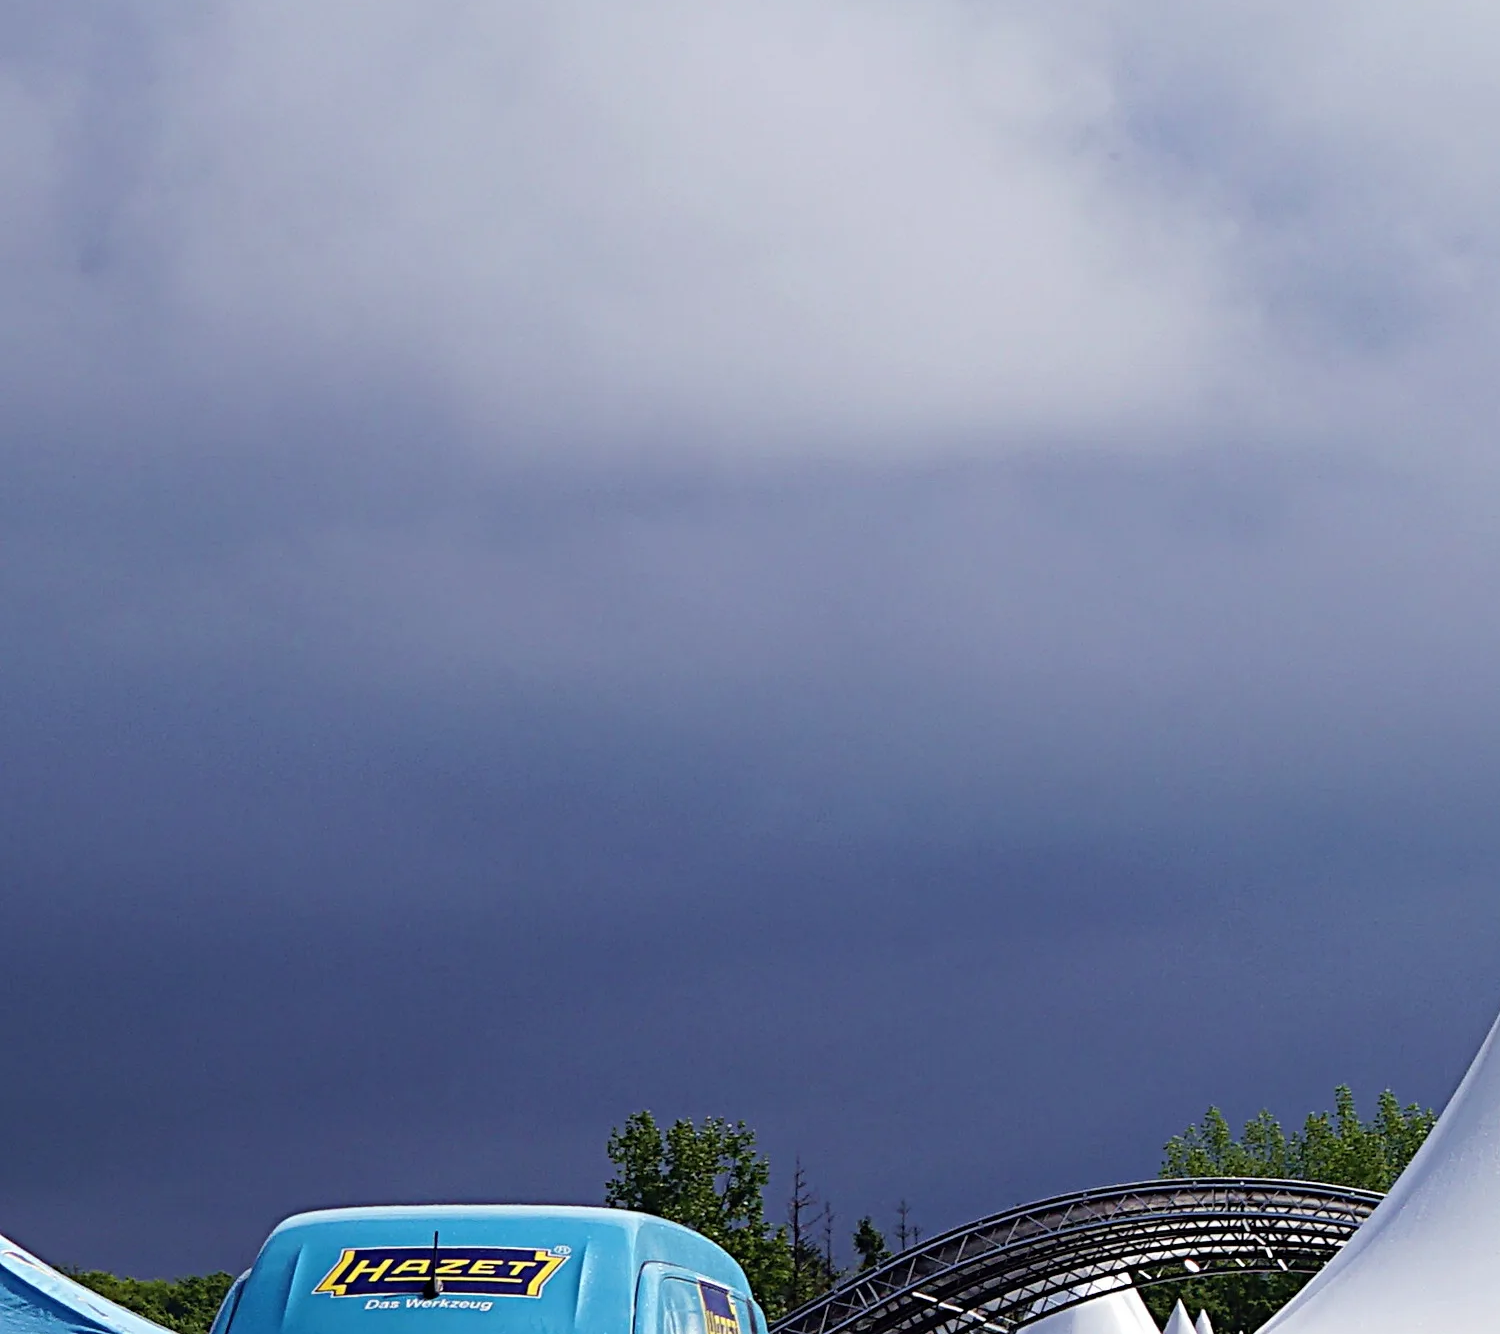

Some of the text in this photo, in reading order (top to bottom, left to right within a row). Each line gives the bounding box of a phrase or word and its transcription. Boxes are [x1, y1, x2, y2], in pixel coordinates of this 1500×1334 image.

[345, 1259, 537, 1283] HAZET
[365, 1298, 493, 1312] Das Werkzeug
